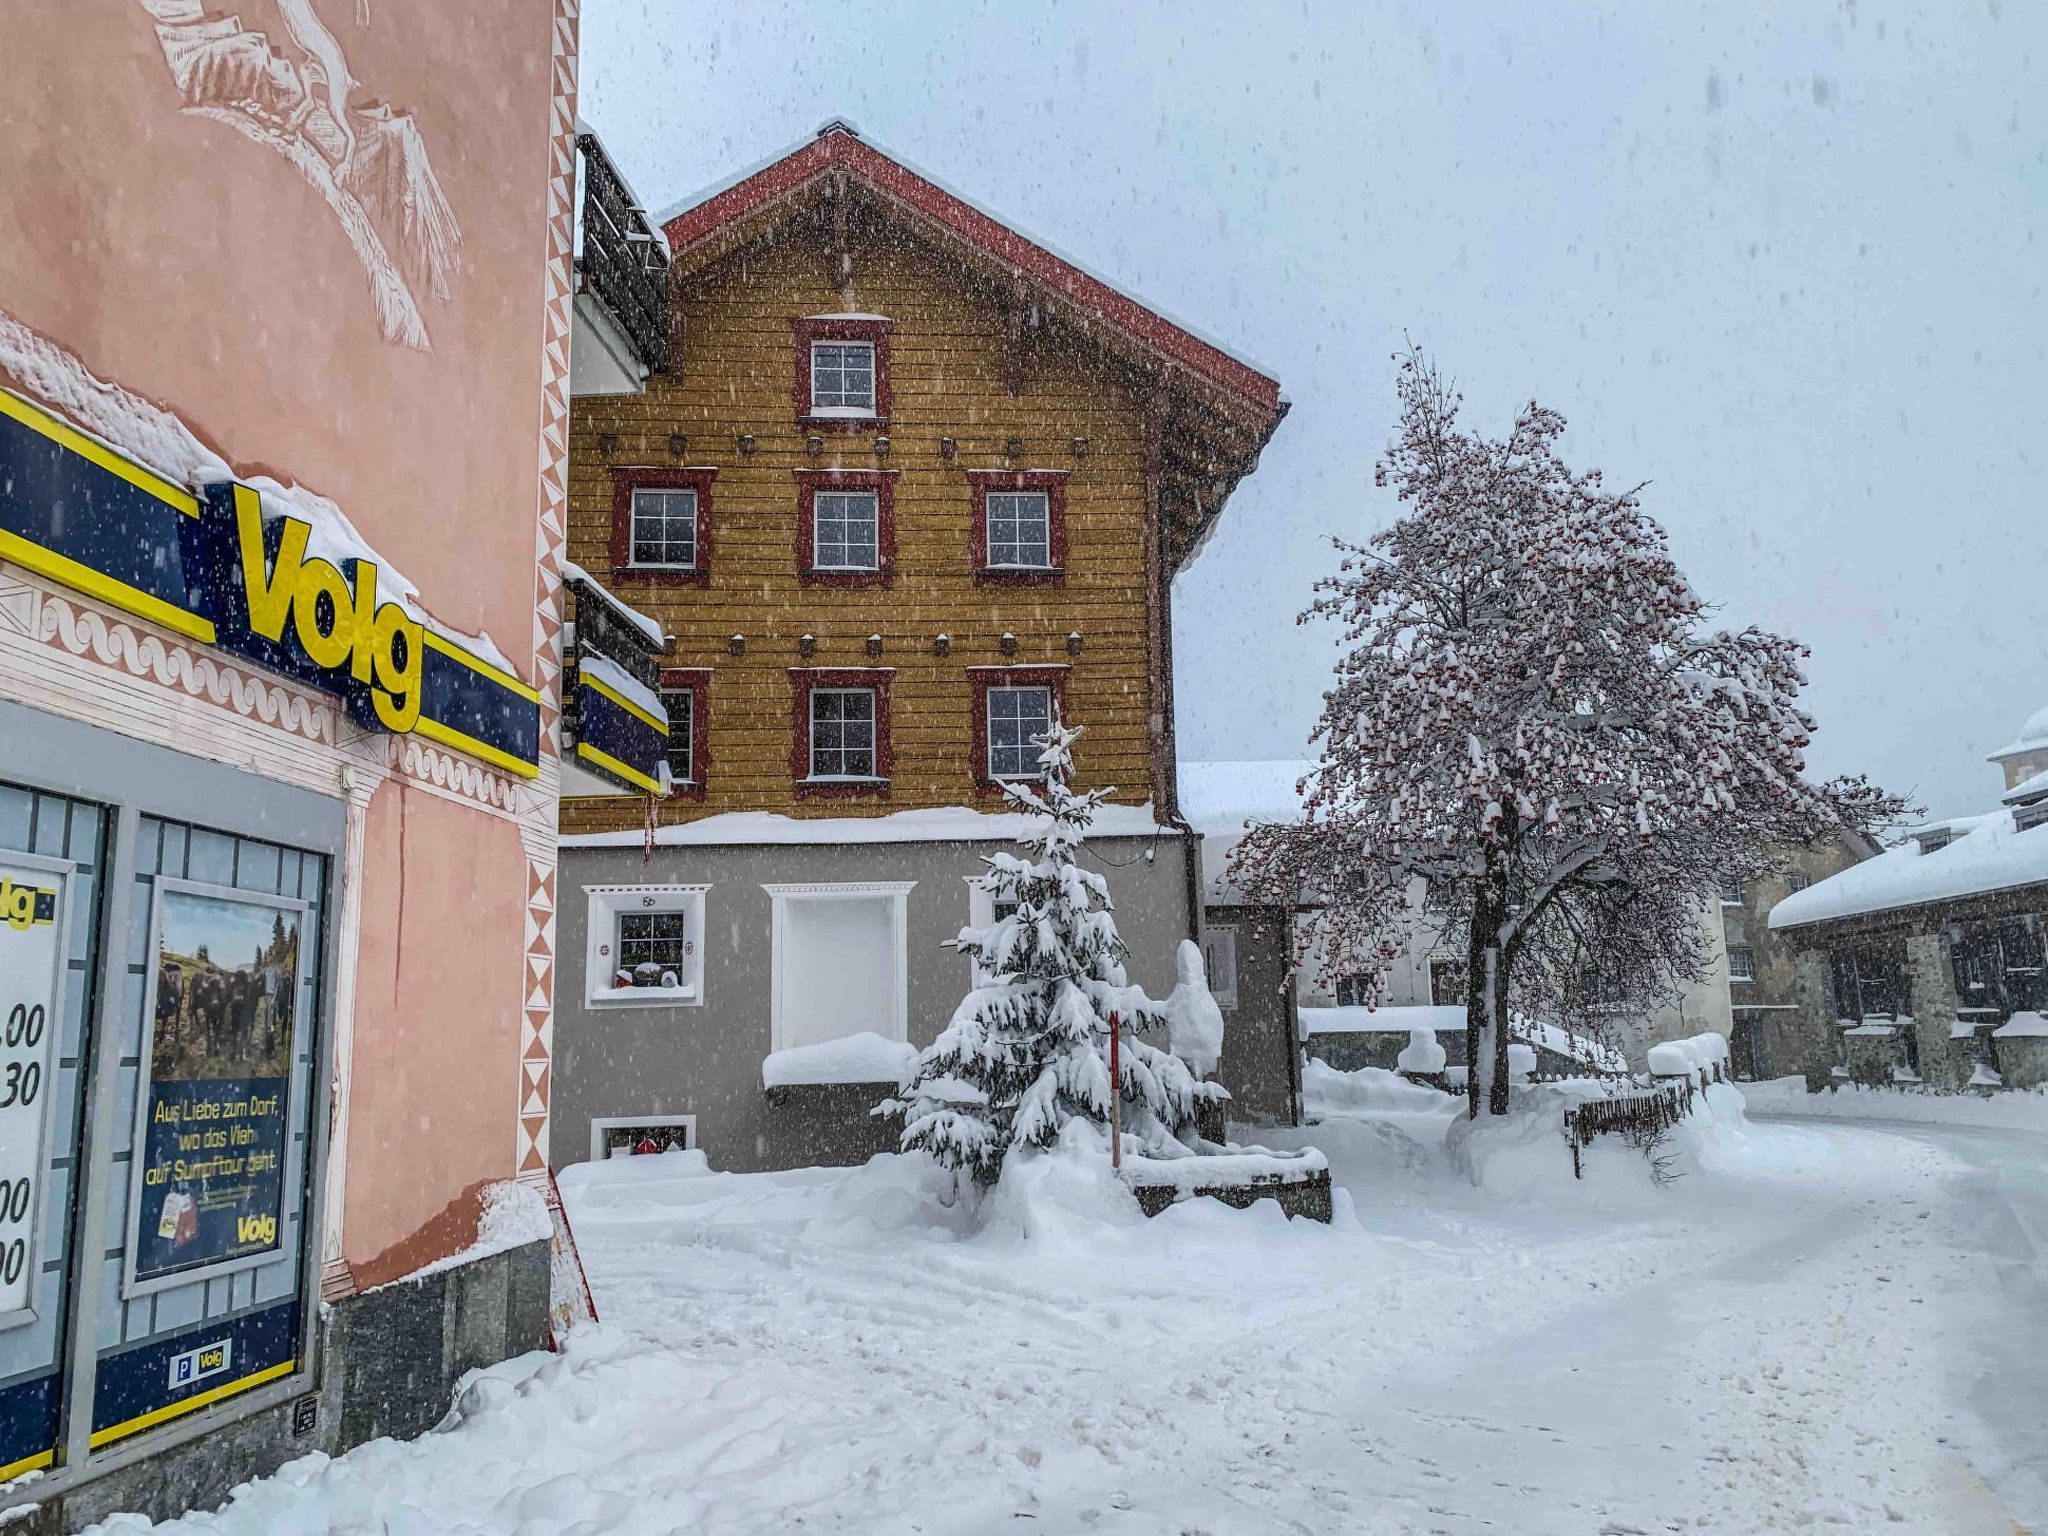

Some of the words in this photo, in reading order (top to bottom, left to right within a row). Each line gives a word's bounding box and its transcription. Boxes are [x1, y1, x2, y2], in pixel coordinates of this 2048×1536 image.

[233, 483, 425, 734] Volg
[0, 877, 36, 931] lg
[182, 1098, 220, 1121] Liebe
[222, 1101, 247, 1118] zum
[180, 1133, 200, 1151] wo
[204, 1127, 227, 1148] das
[230, 1123, 256, 1146] Vieh
[146, 1160, 171, 1186] auf
[237, 1213, 278, 1244] Volg
[0, 1238, 25, 1285] 0
[180, 1361, 189, 1379] P
[200, 1350, 224, 1369] Volg
